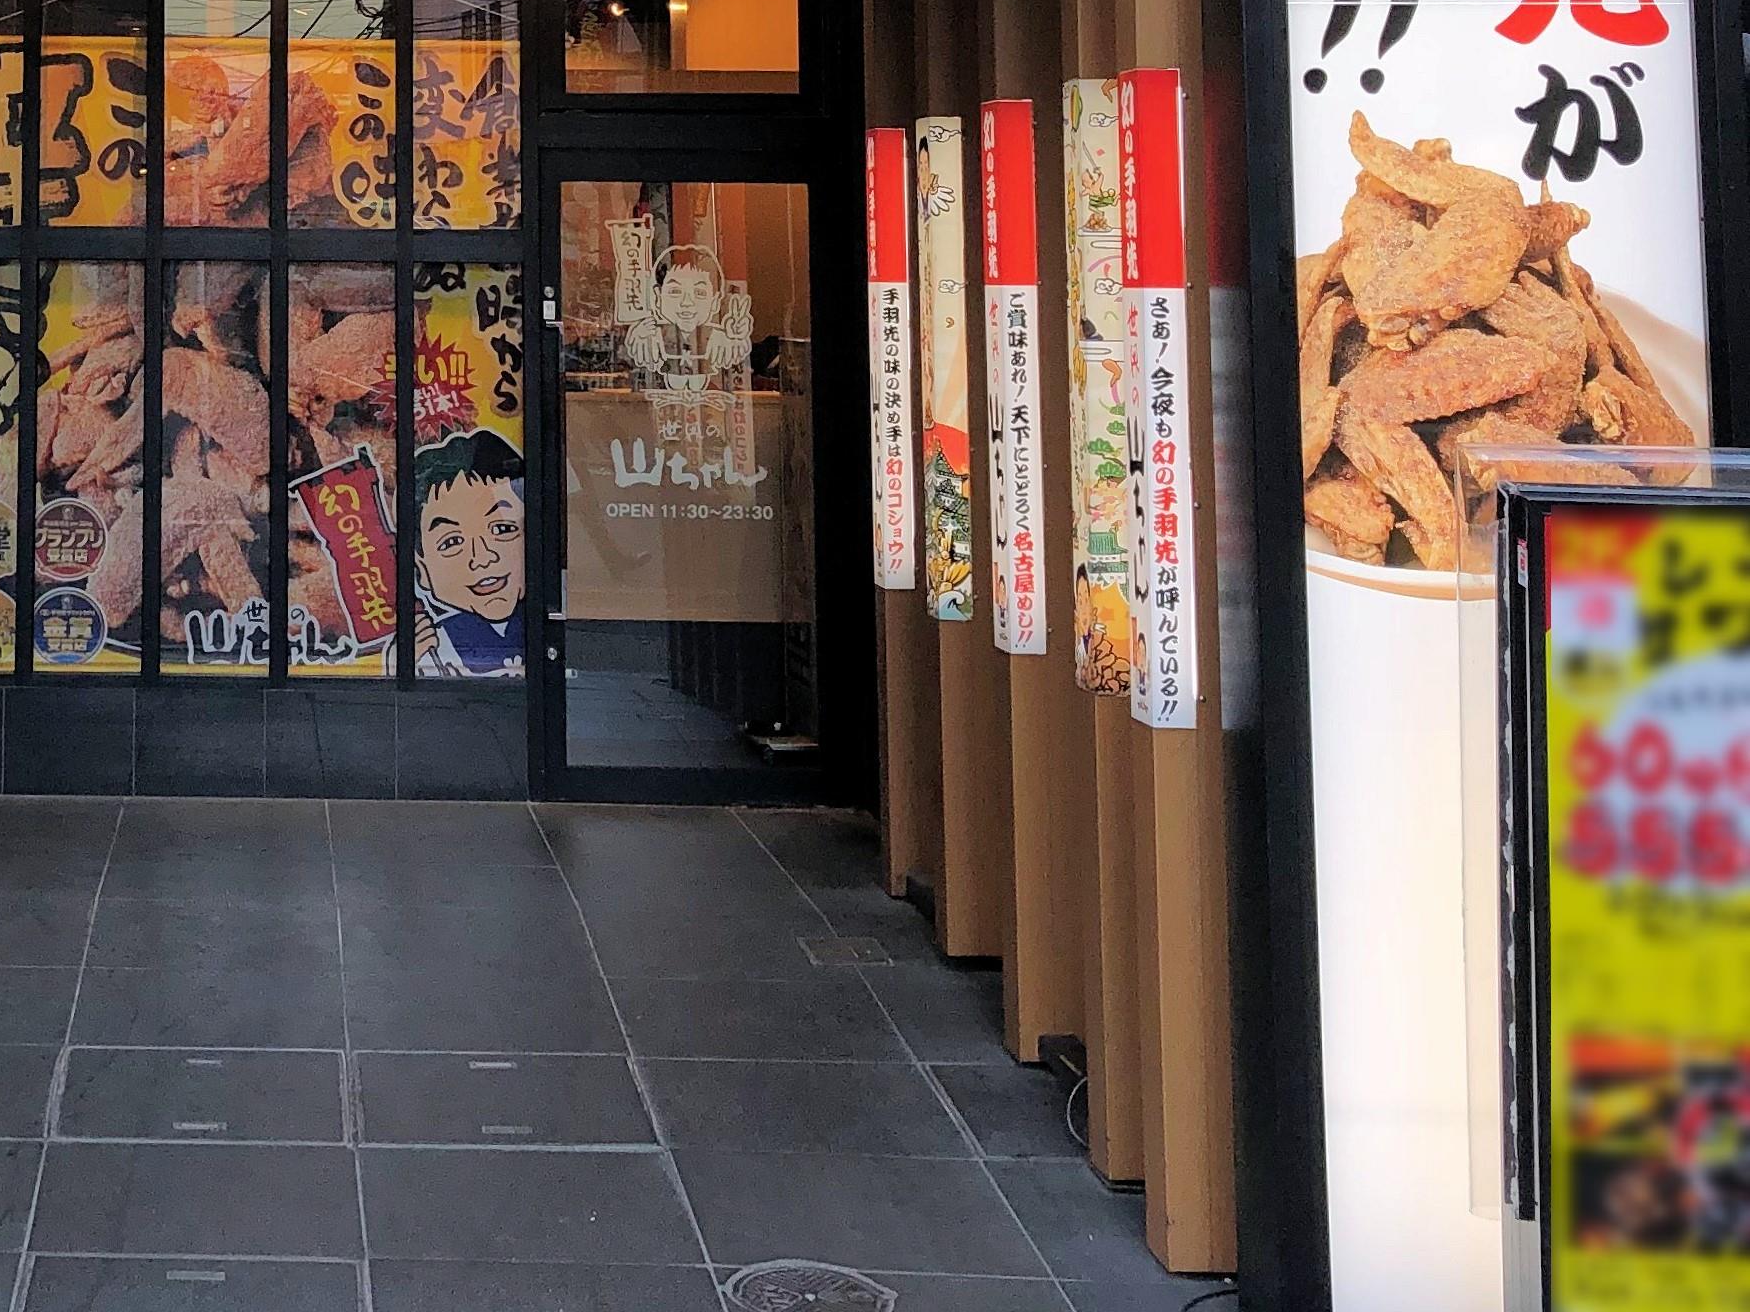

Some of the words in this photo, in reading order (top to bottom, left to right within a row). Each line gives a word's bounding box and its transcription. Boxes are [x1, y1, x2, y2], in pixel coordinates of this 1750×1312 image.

[610, 438, 769, 491] 山ちゃん
[606, 502, 654, 519] OPEN
[35, 528, 105, 548] グランプリ
[318, 484, 397, 632] 幻の手羽先
